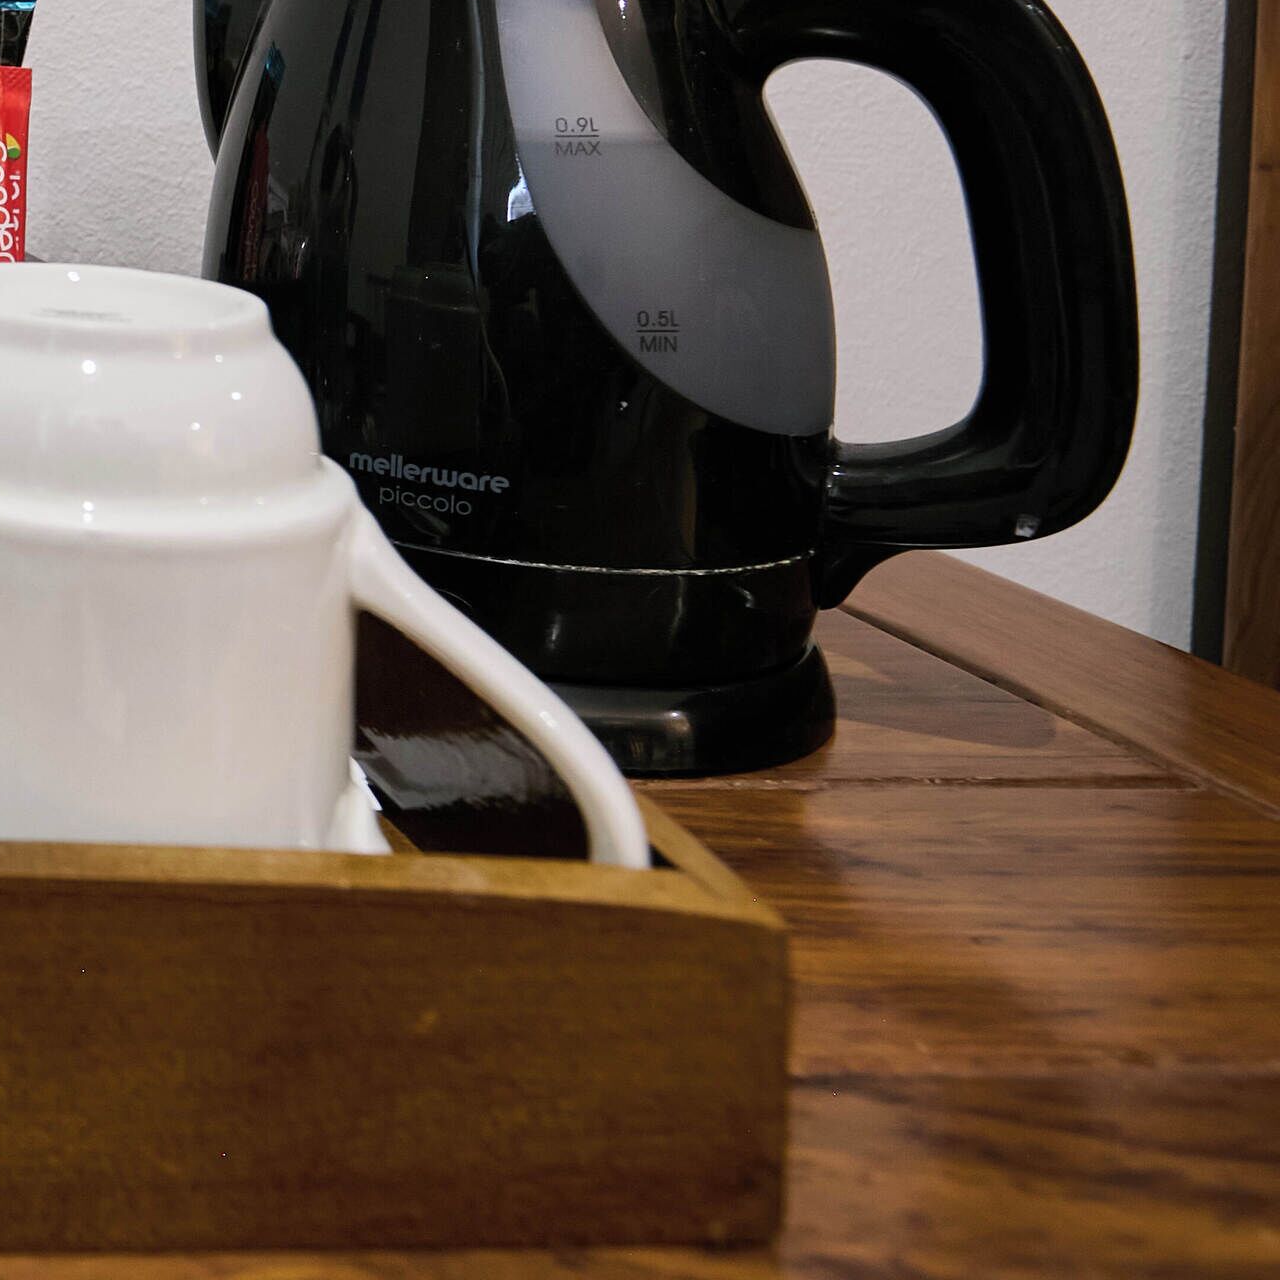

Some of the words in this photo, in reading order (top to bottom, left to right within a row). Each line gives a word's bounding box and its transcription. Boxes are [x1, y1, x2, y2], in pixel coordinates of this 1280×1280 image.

[555, 117, 600, 133] 0.9L
[555, 141, 602, 156] MAX
[637, 310, 680, 327] 0.5L
[640, 336, 678, 352] MIN
[349, 452, 511, 494] mellerware
[379, 485, 472, 516] piccolo
